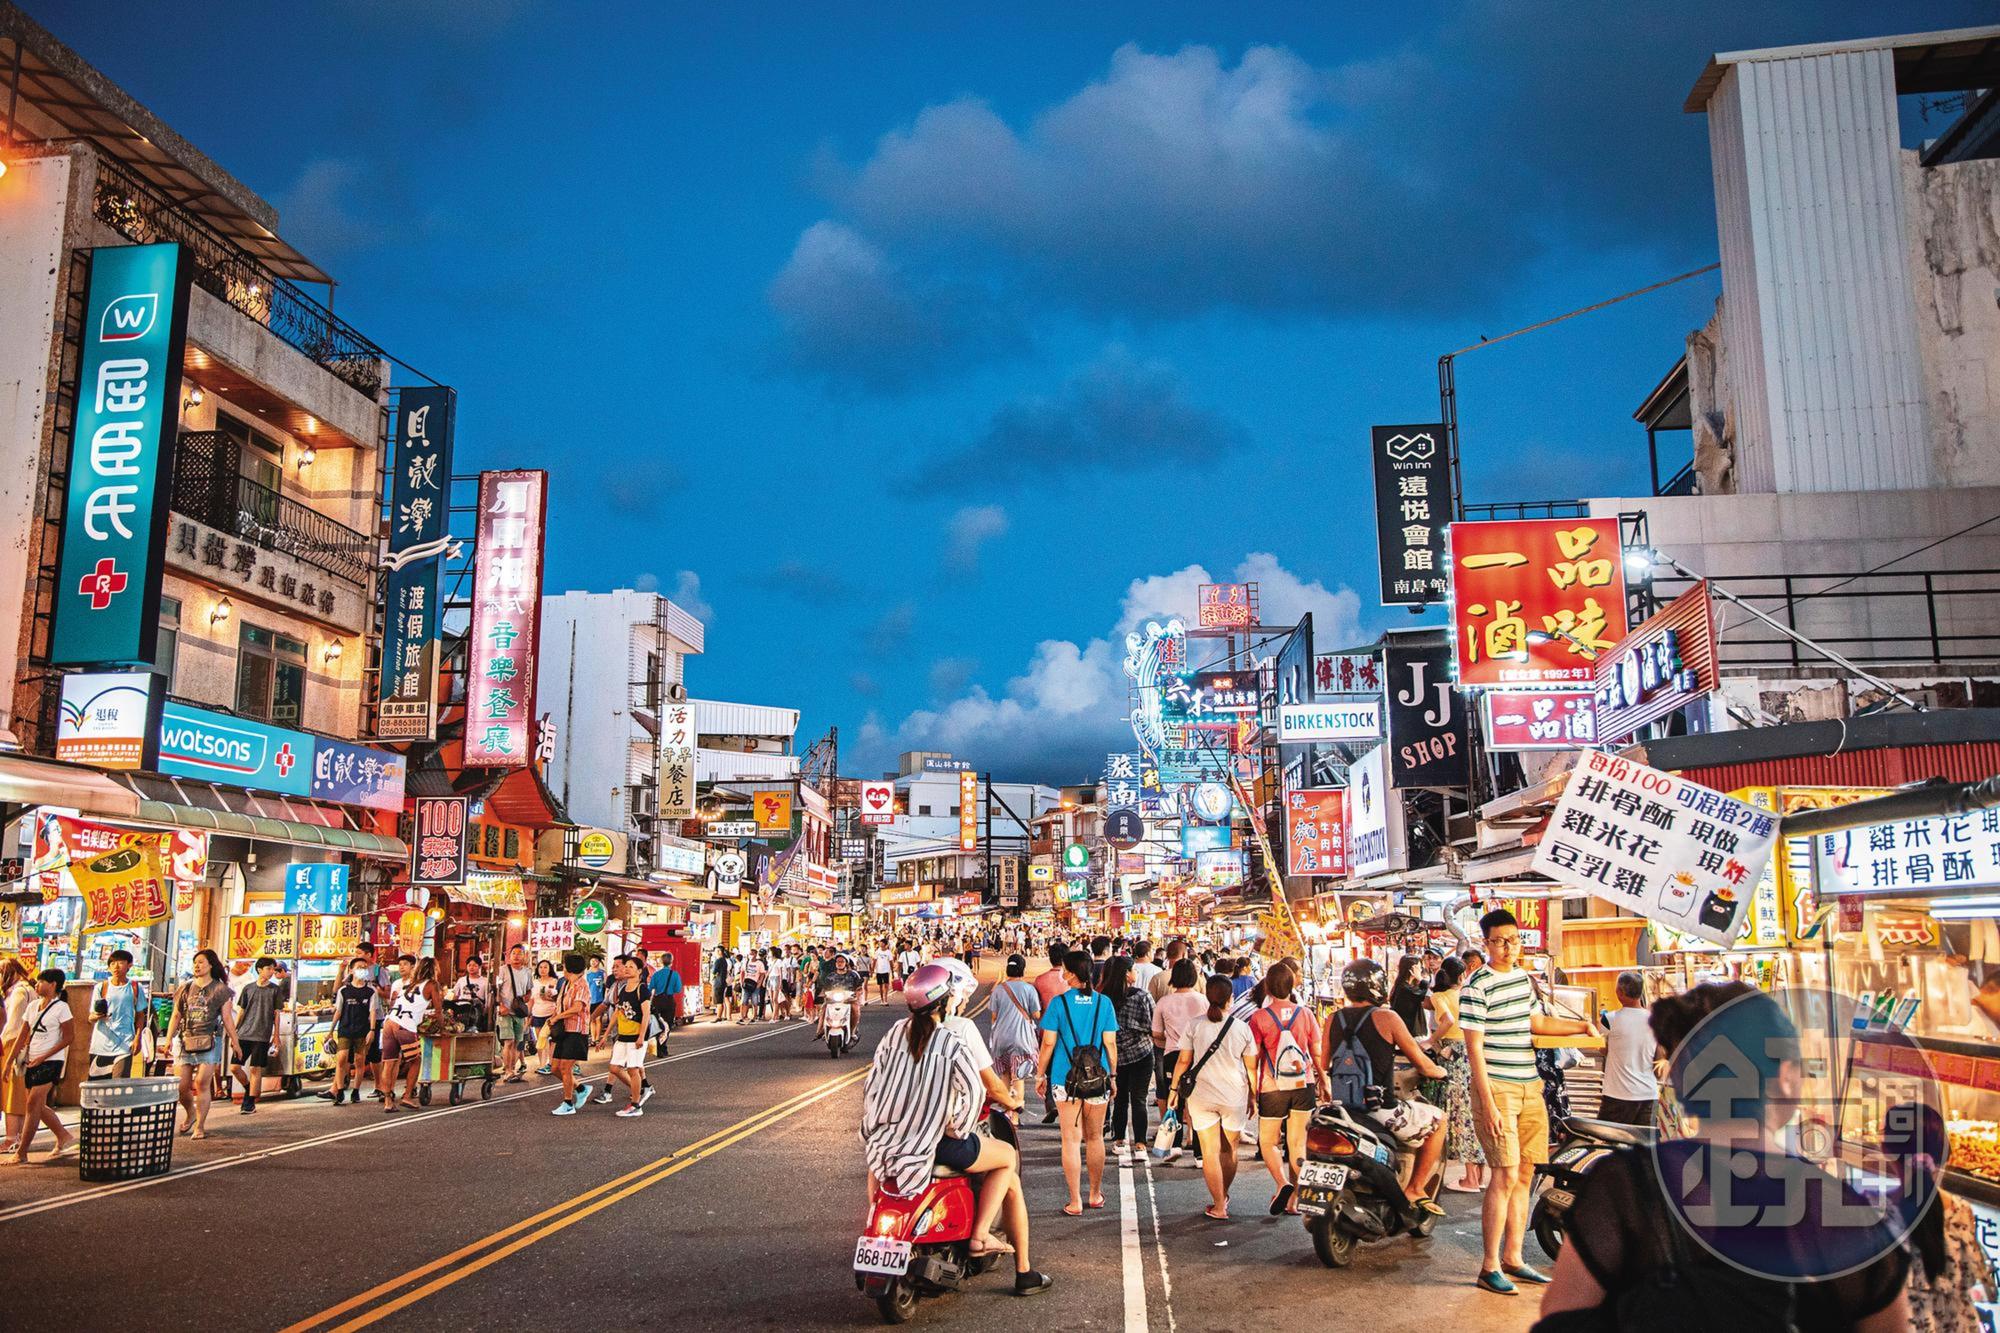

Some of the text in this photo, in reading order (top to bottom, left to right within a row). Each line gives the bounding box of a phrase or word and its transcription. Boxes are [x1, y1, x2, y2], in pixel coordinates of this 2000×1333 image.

[84, 357, 149, 542] 屈臣氏
[399, 404, 441, 541] 貝殼灣
[1460, 526, 1613, 590] 一品
[402, 585, 426, 698] 渡假旅館
[1466, 597, 1618, 663] 滷味
[383, 704, 427, 716] 備停車場
[478, 621, 519, 755] 音樂餐廳
[160, 724, 251, 762] watsons
[1283, 711, 1376, 731] BIRKENSTOCK
[313, 747, 378, 792] 貝殼灣
[1400, 731, 1457, 769] SHOP
[420, 800, 463, 837] 100
[1576, 775, 1740, 855] 排骨酥 現做
[1676, 783, 1776, 839] 可混搭2種
[1546, 839, 1649, 898] 豆乳雞
[1561, 808, 1752, 885] 雞米花 現炸
[1871, 850, 1976, 887] 排骨酥
[294, 866, 319, 913] 貝殼
[856, 1247, 908, 1270] 868-DZW
